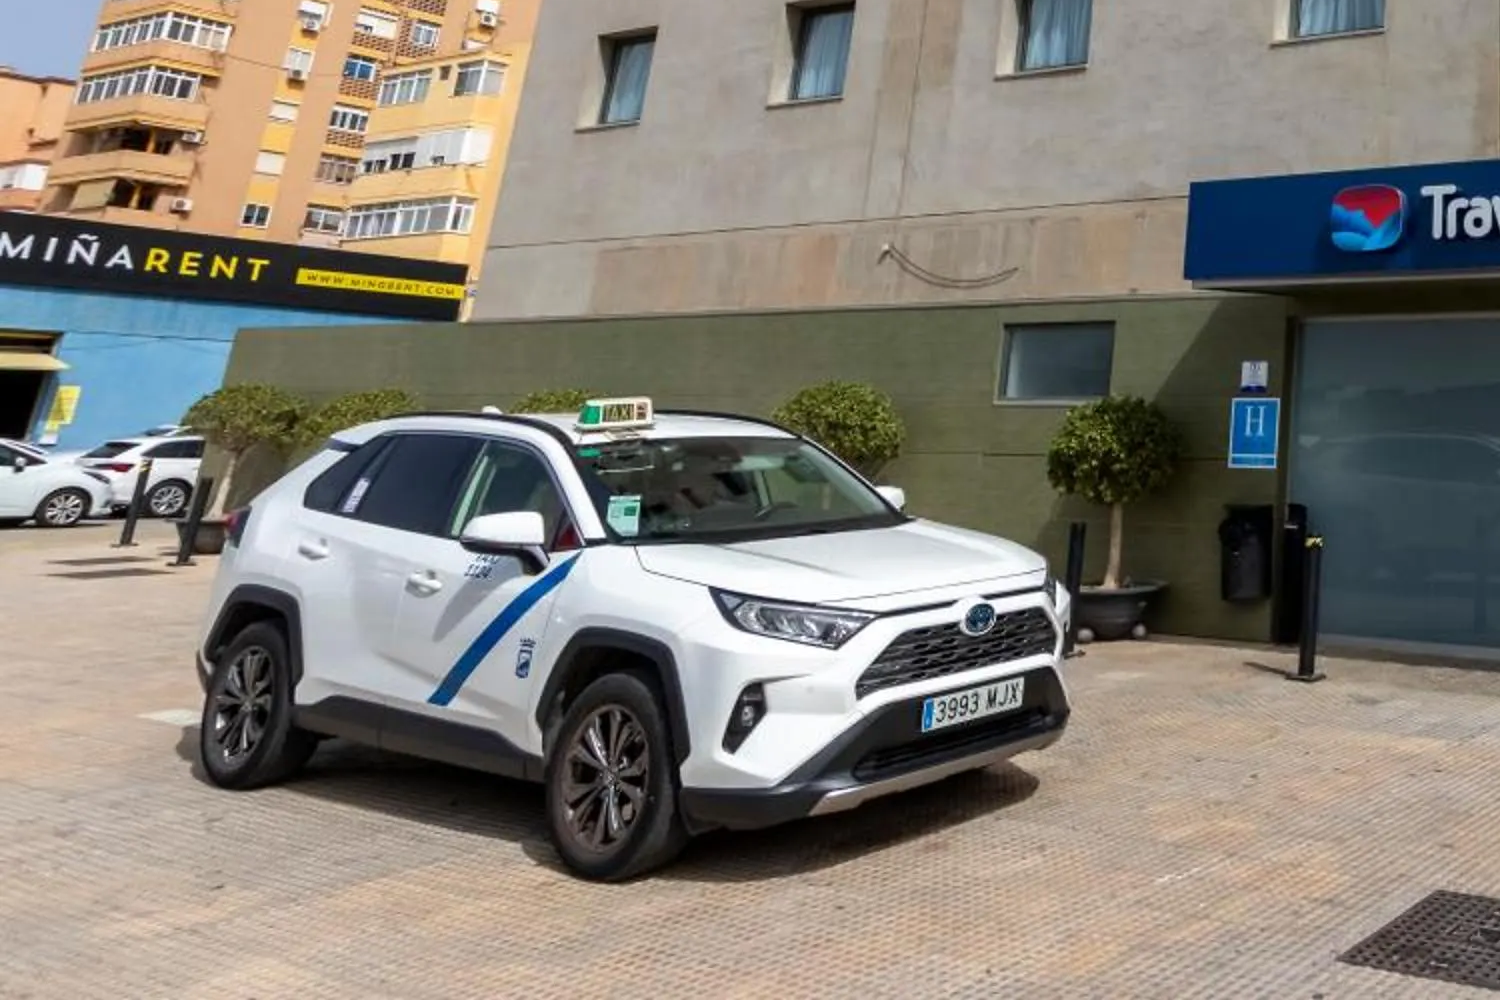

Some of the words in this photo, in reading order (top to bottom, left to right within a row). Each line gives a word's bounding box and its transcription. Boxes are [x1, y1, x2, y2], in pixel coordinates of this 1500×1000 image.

[604, 404, 635, 421] TAXI
[1244, 404, 1268, 438] H
[936, 691, 980, 723] 3993
[986, 681, 1020, 712] MJX
